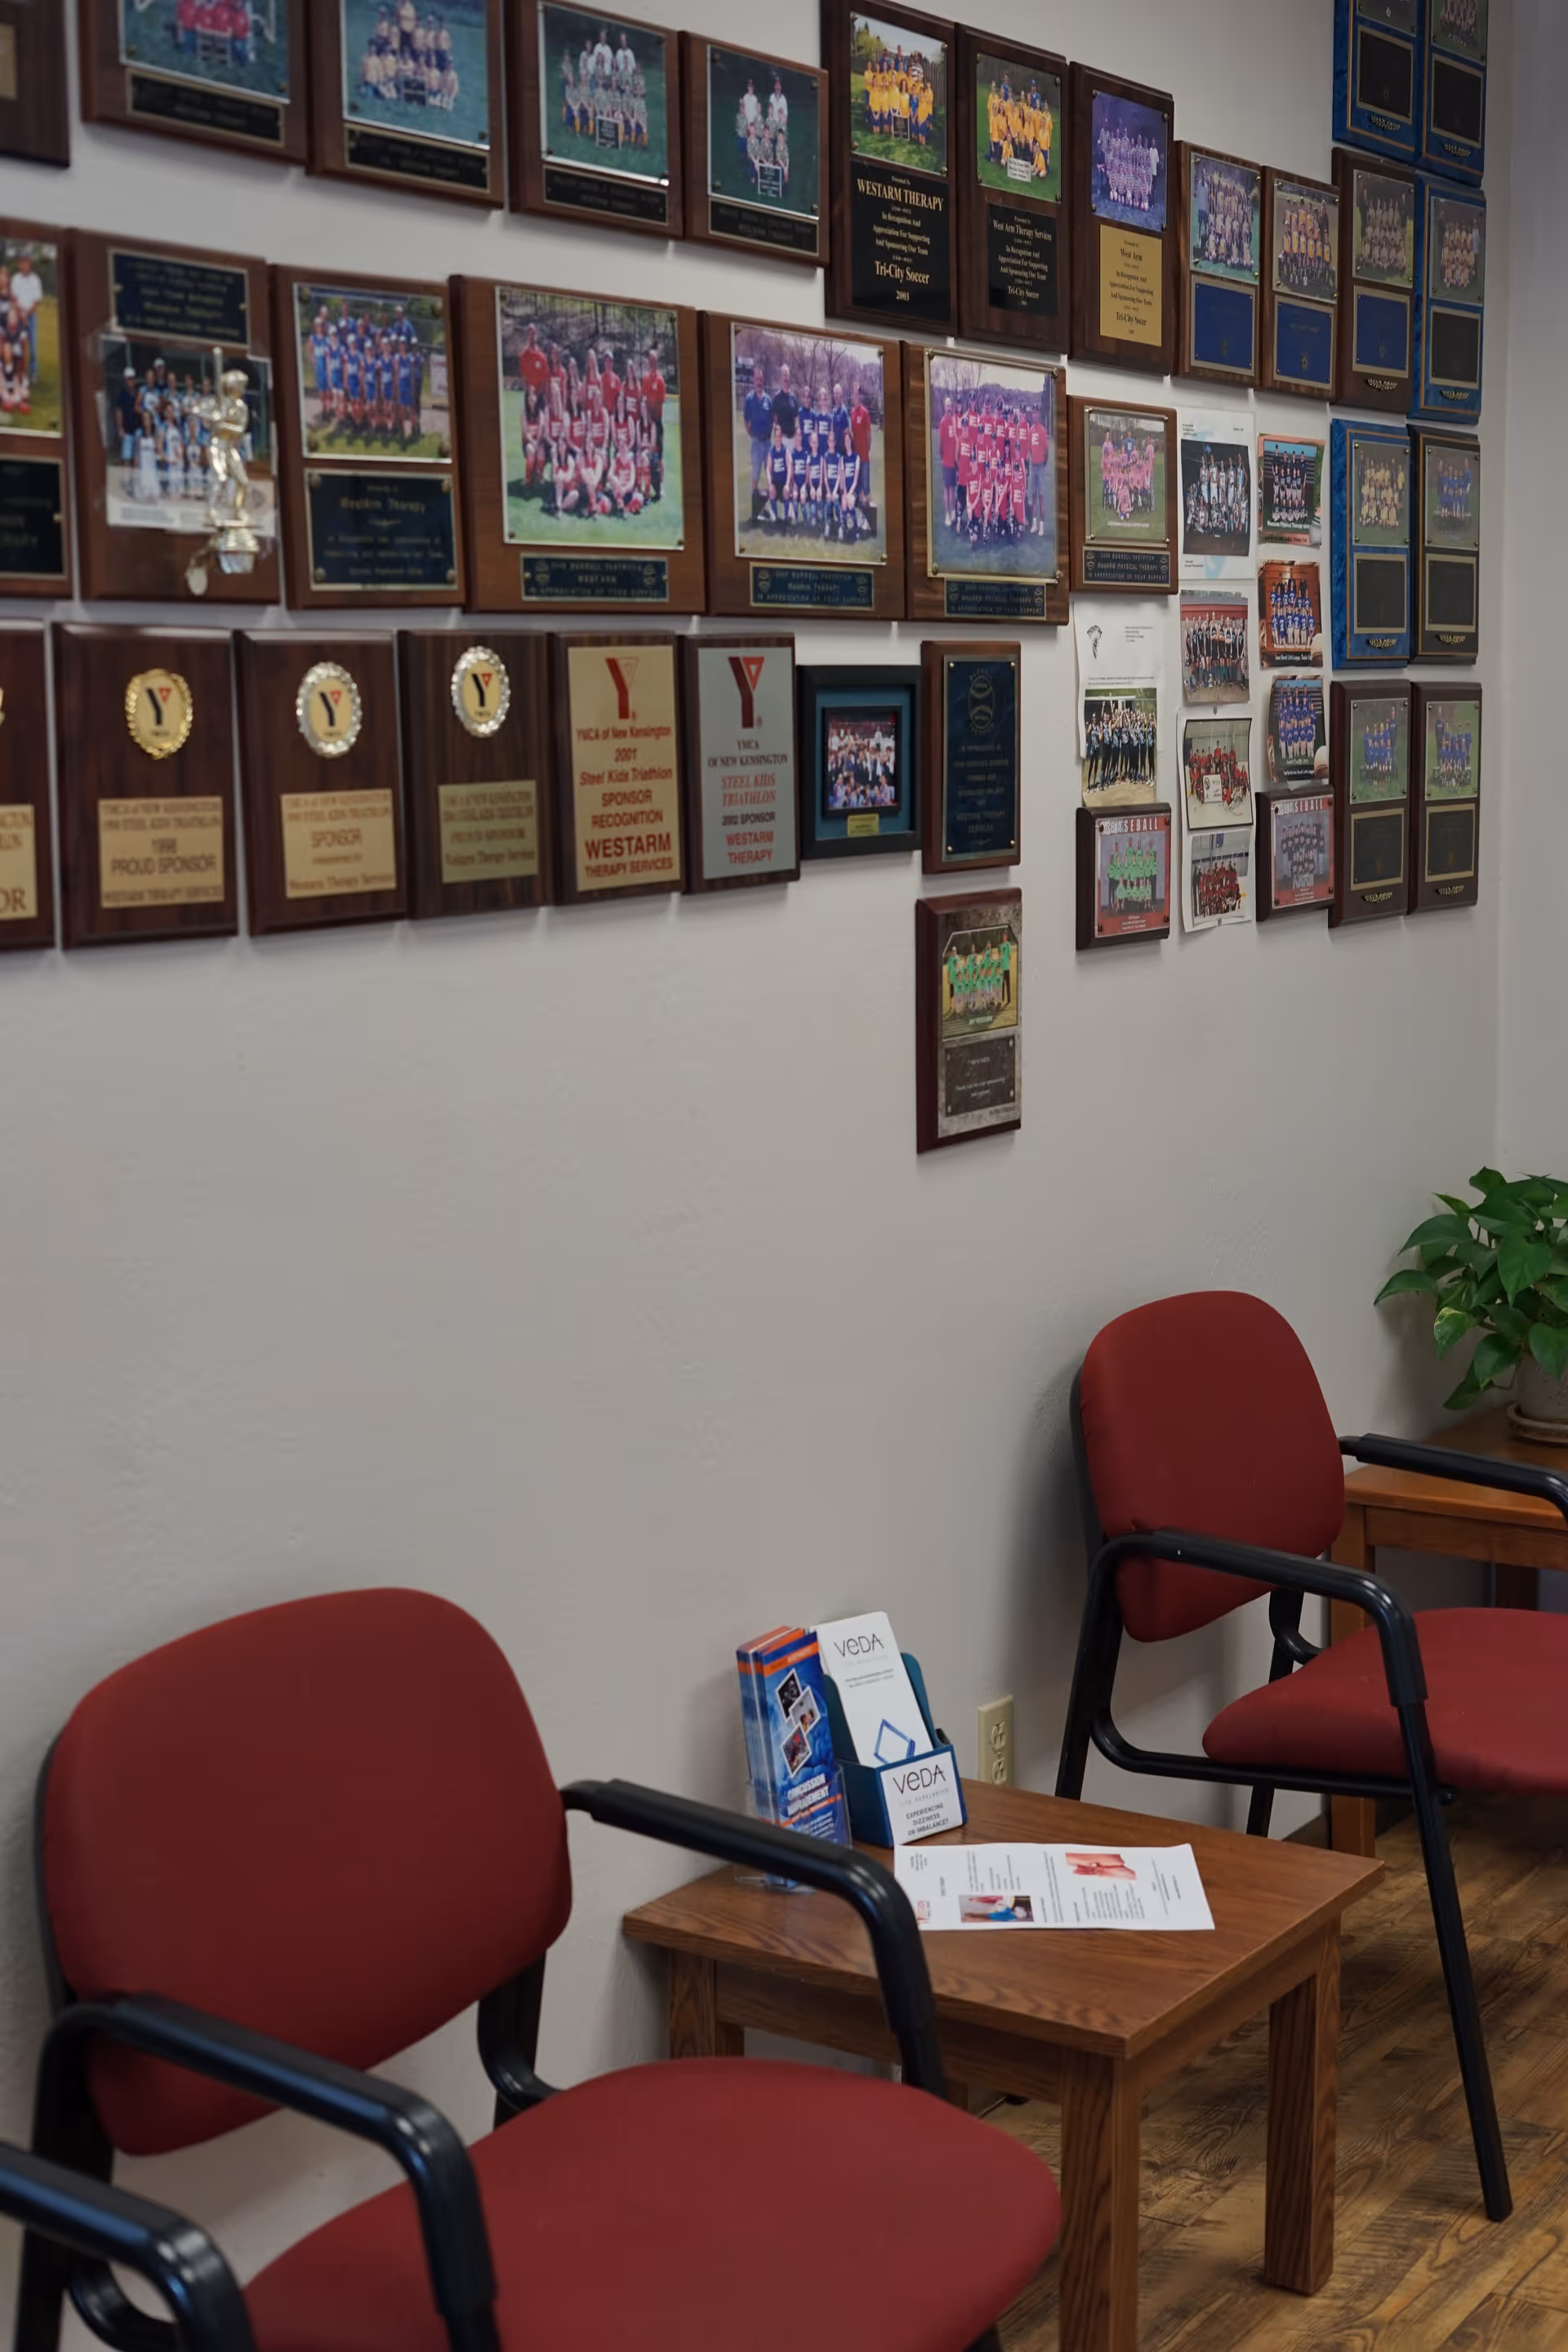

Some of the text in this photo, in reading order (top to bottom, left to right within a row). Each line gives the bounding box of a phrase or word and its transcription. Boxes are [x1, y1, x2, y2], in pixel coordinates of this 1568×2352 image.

[858, 178, 943, 212] WESTARM THERAPY
[882, 212, 921, 228] In Recognition And
[873, 224, 930, 245] Appreciation For Supporting
[993, 219, 1052, 242] West Arm Therapy Services
[875, 238, 929, 256] And Sponsoring Our Team
[1032, 250, 1040, 259] And
[1120, 248, 1143, 262] West Arm
[875, 261, 929, 285] Tri-City Soccer
[1000, 266, 1009, 274] And
[896, 290, 910, 301] 2003
[1008, 286, 1040, 300] Tri-City Soccer
[1116, 312, 1134, 326] Tri-City
[577, 725, 671, 742] YMCA of New Kensington
[737, 739, 760, 751] YMCA
[614, 747, 637, 763] 2001
[707, 753, 789, 768] OF NEW KENSINGTON
[580, 768, 673, 786] Steel Kids Triathlon
[721, 773, 776, 790] STEEL KIDS
[601, 789, 653, 807] SPONSOR
[722, 789, 777, 808] TRIATHLON
[591, 810, 664, 829] RECOGNITION
[740, 811, 776, 825] SPONSOR
[312, 828, 363, 849] SPONSOR
[585, 832, 671, 860] WESTARM
[726, 830, 774, 847] WESTARM
[110, 853, 217, 876] PROUD SPONSOR
[727, 849, 773, 866] THERAPY
[585, 857, 674, 877] THERAPY SERVICES
[787, 1772, 826, 1801] CONCUSSION
[906, 1802, 944, 1820] EXPERIENCING
[913, 1812, 940, 1826] DIZZINESS
[916, 1819, 949, 1833] IMBALANCE?
